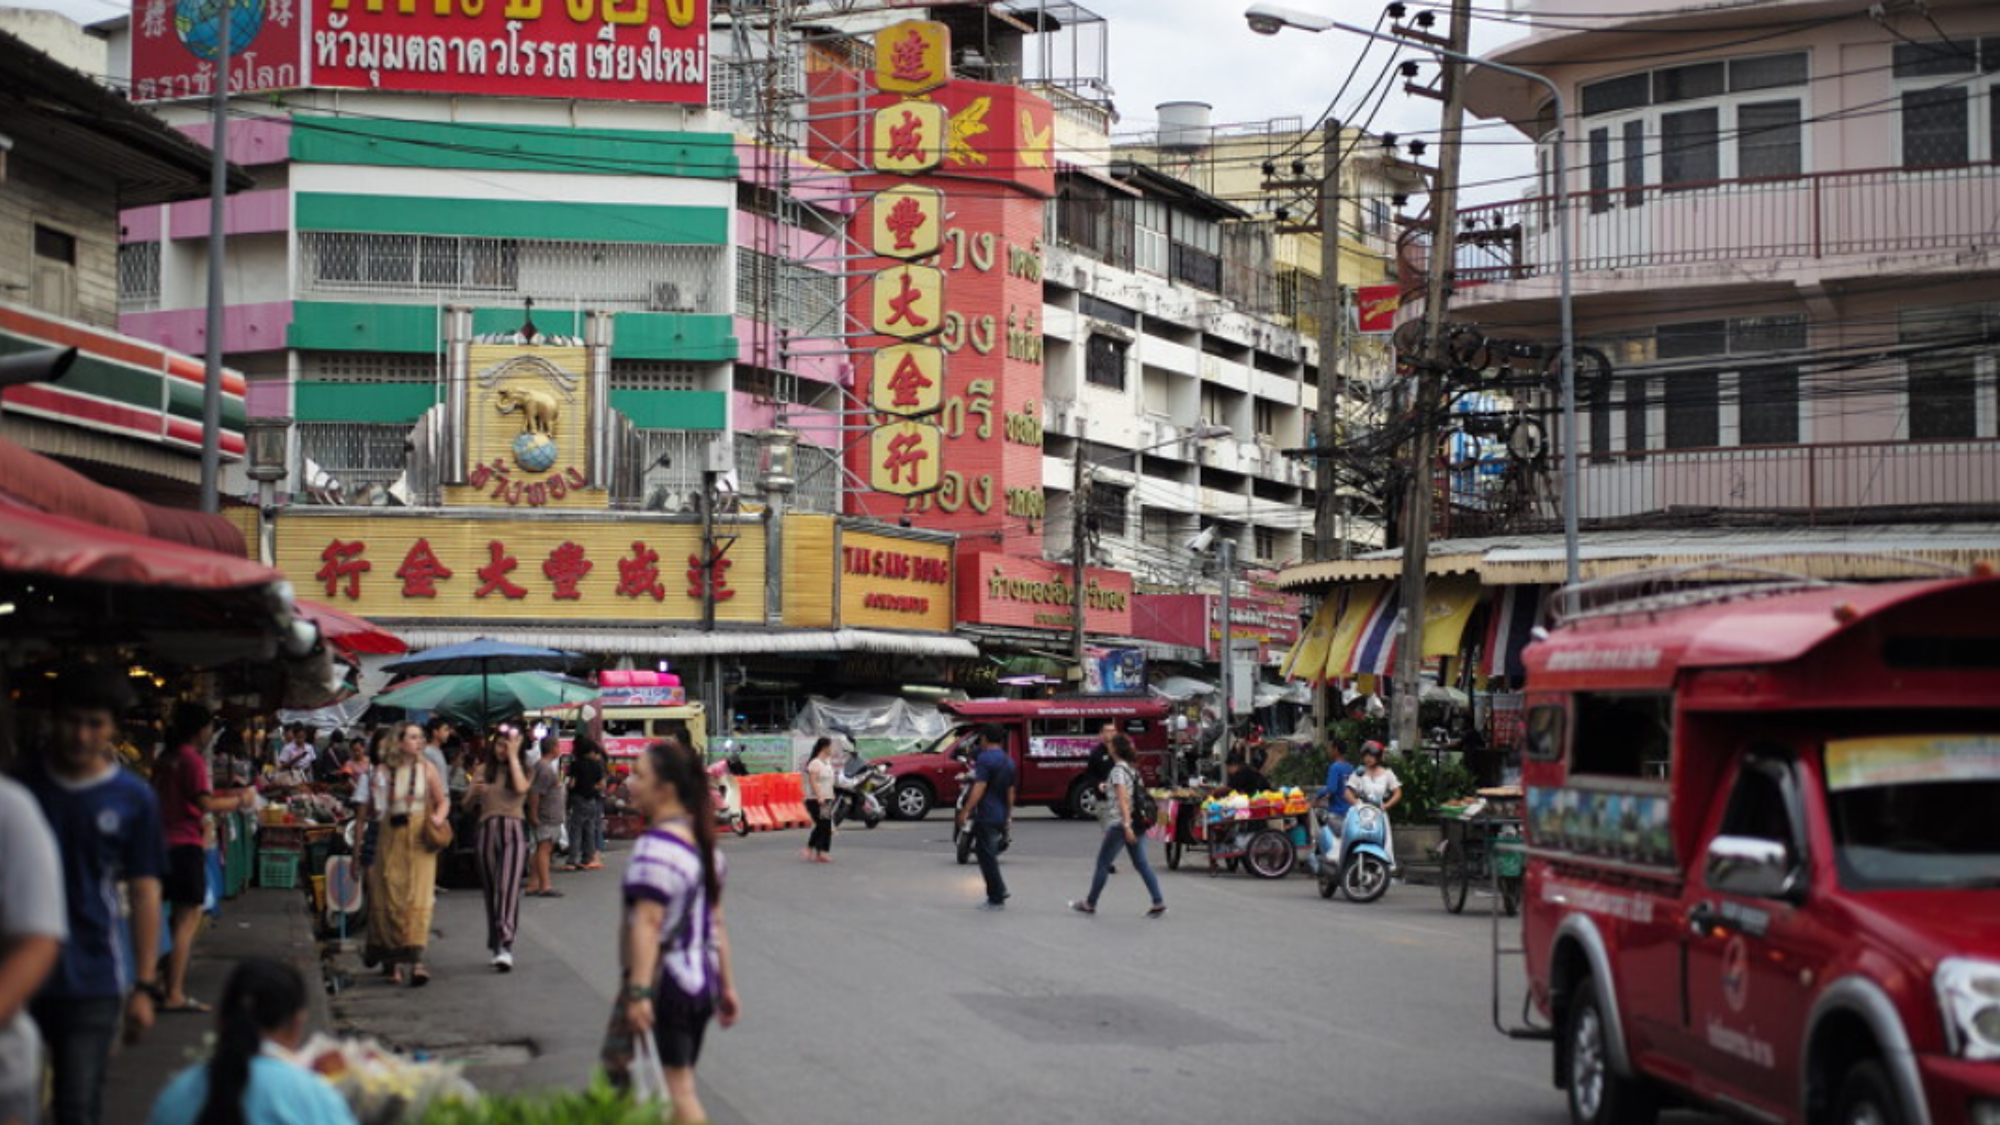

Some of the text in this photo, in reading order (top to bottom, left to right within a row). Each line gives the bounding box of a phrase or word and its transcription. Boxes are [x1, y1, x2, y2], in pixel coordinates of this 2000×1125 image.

[137, 52, 294, 100] ตราช้งโลก
[585, 23, 705, 84] เชียงใหม่
